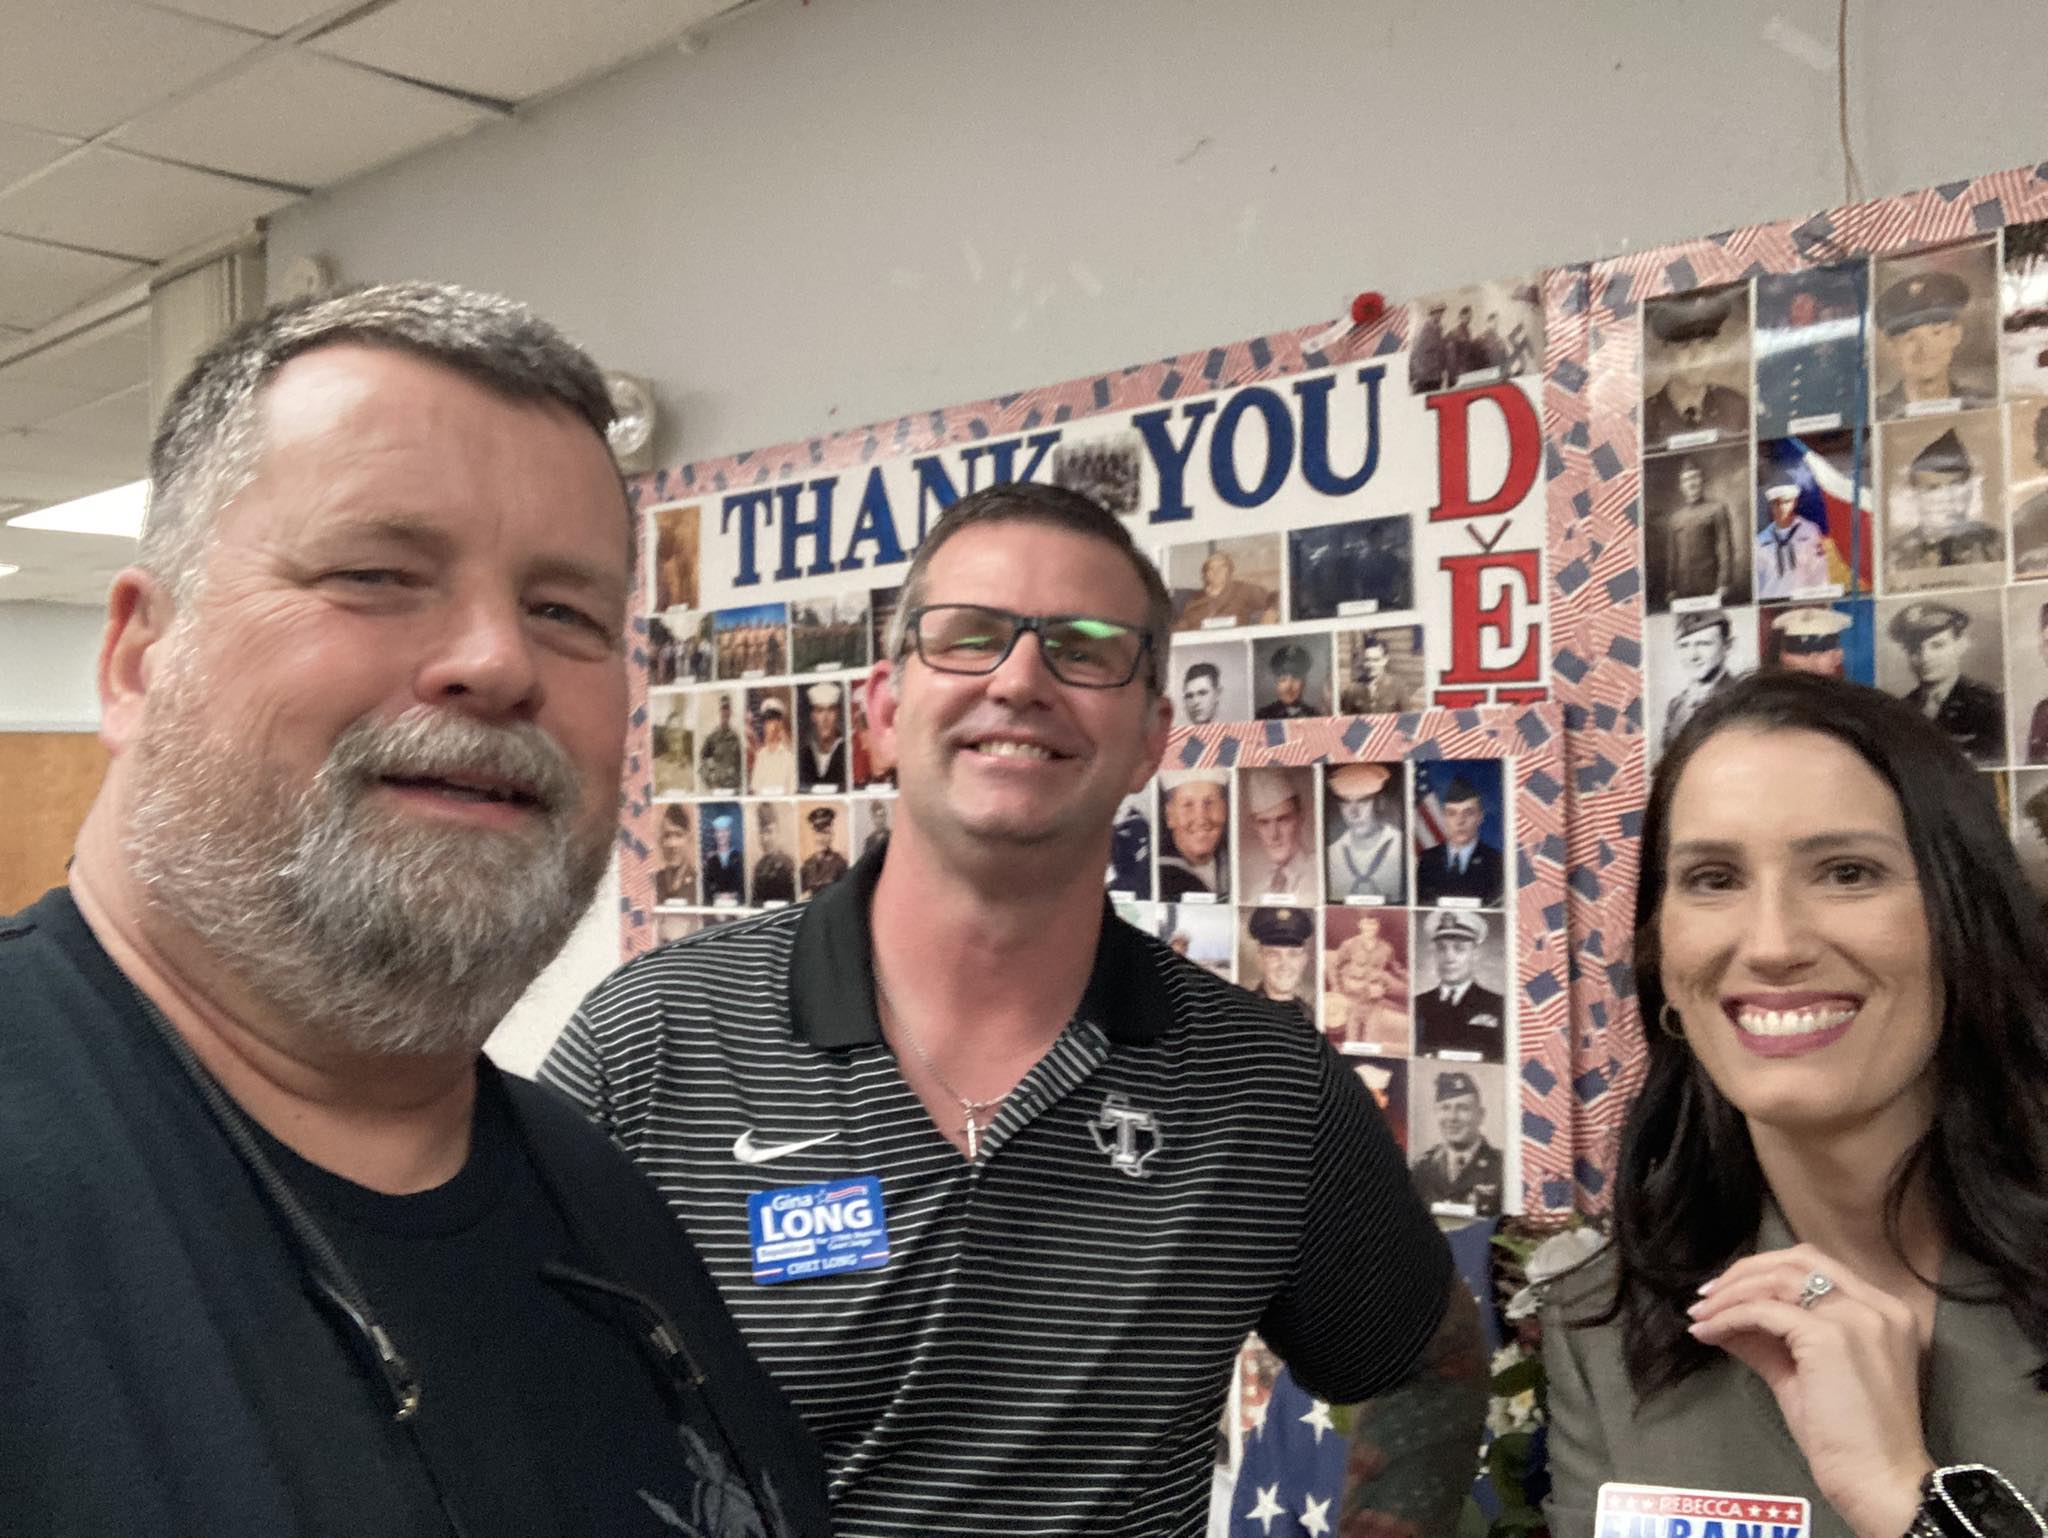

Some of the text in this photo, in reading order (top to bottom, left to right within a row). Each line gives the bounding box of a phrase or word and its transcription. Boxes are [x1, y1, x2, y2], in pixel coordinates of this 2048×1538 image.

[1131, 363, 1386, 525] YOU
[772, 1194, 813, 1211] Gina
[760, 1199, 873, 1242] LONG
[1658, 1496, 1744, 1517] REBECCA
